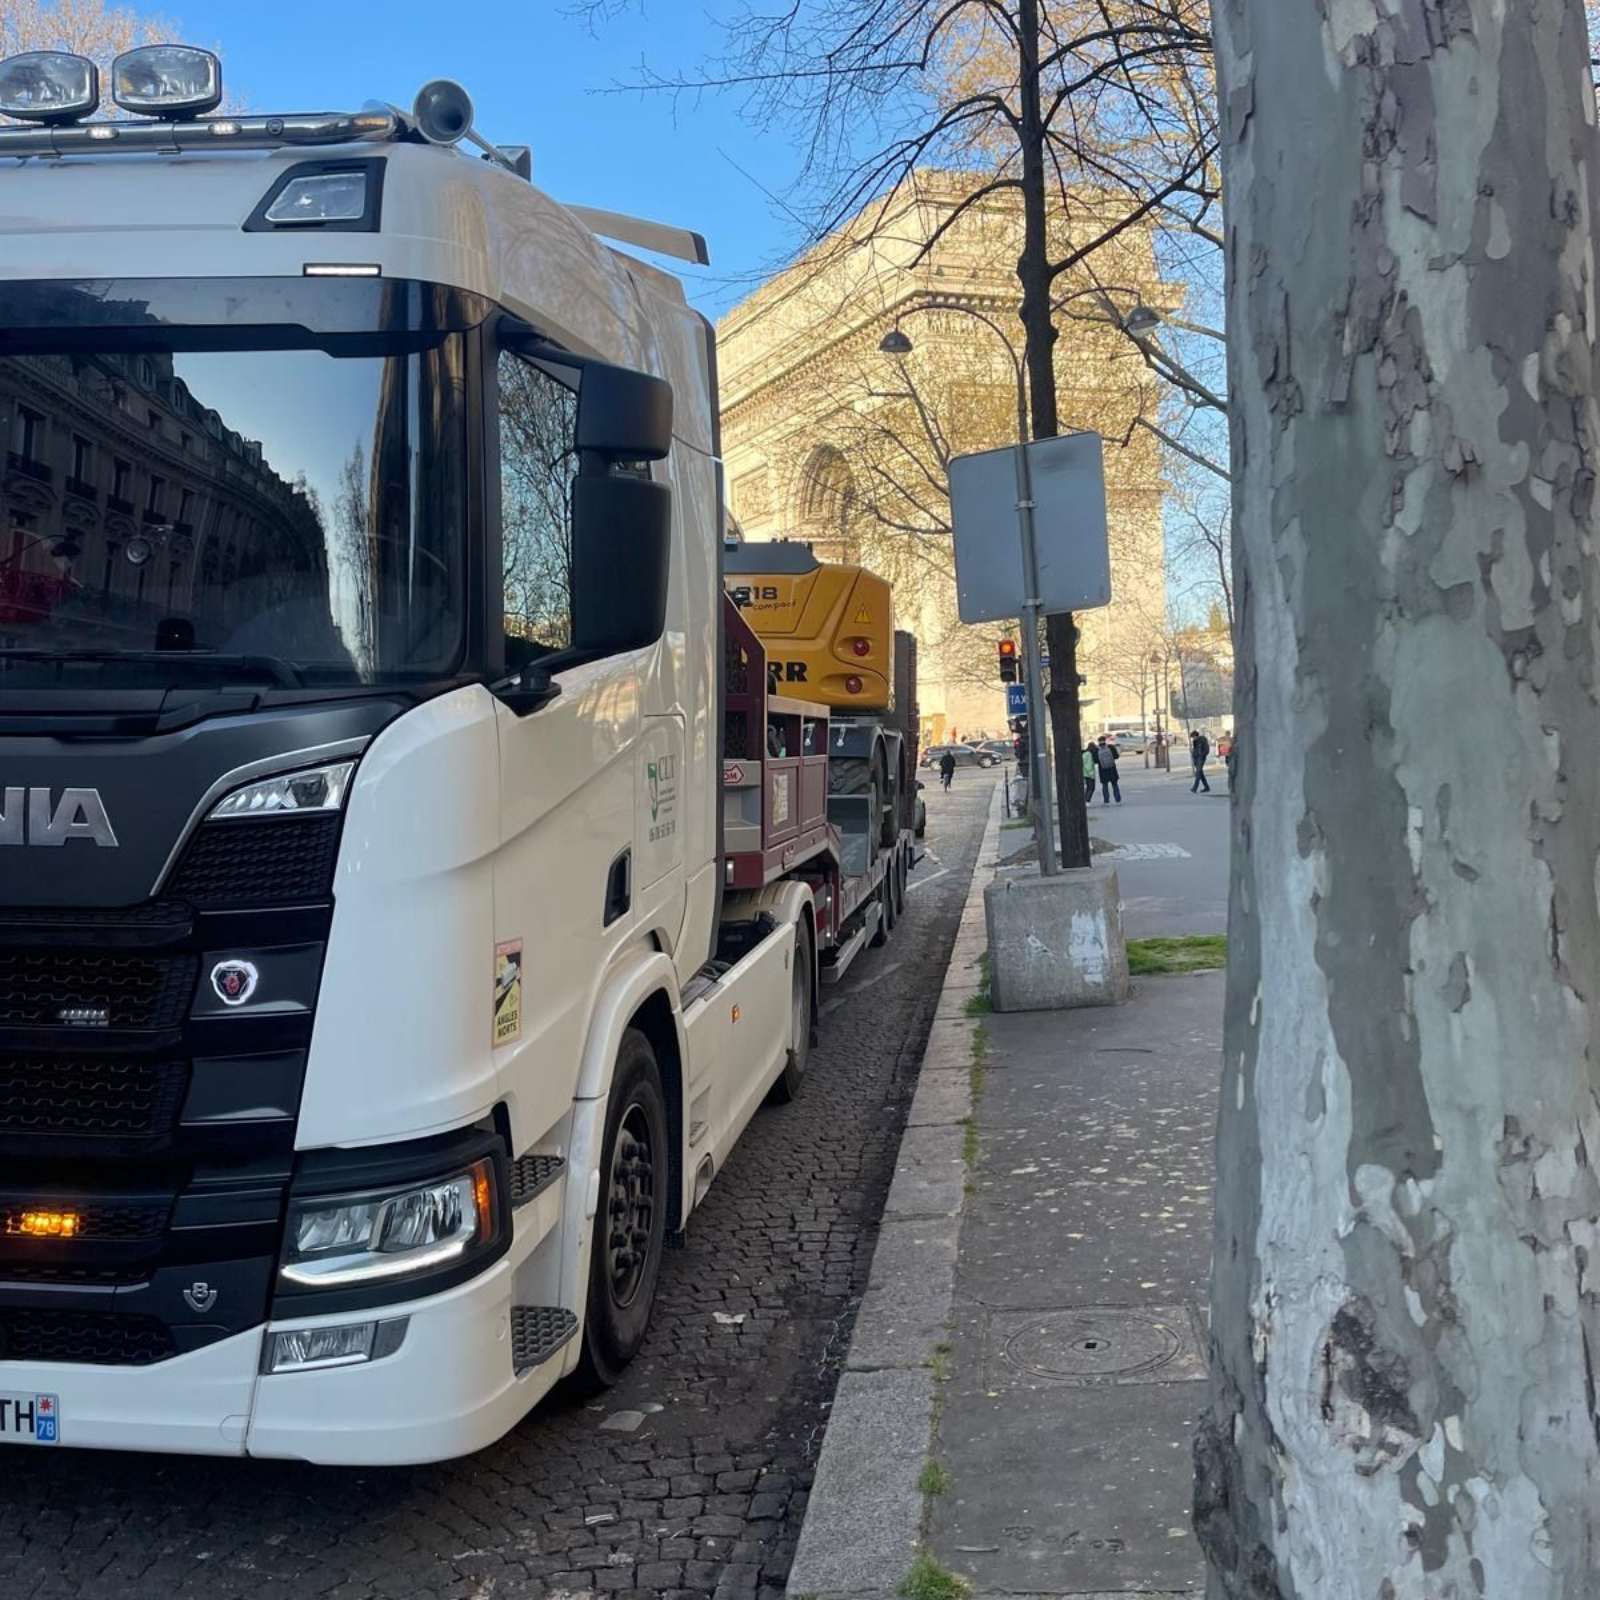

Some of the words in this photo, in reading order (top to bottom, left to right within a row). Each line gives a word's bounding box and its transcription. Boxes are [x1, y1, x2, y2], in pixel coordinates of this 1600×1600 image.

[753, 600, 797, 612] compact
[658, 754, 676, 781] CLT
[497, 1010, 518, 1026] ANGLES
[497, 1021, 517, 1039] MORTS
[0, 1399, 34, 1433] TH
[38, 1420, 54, 1437] 78
